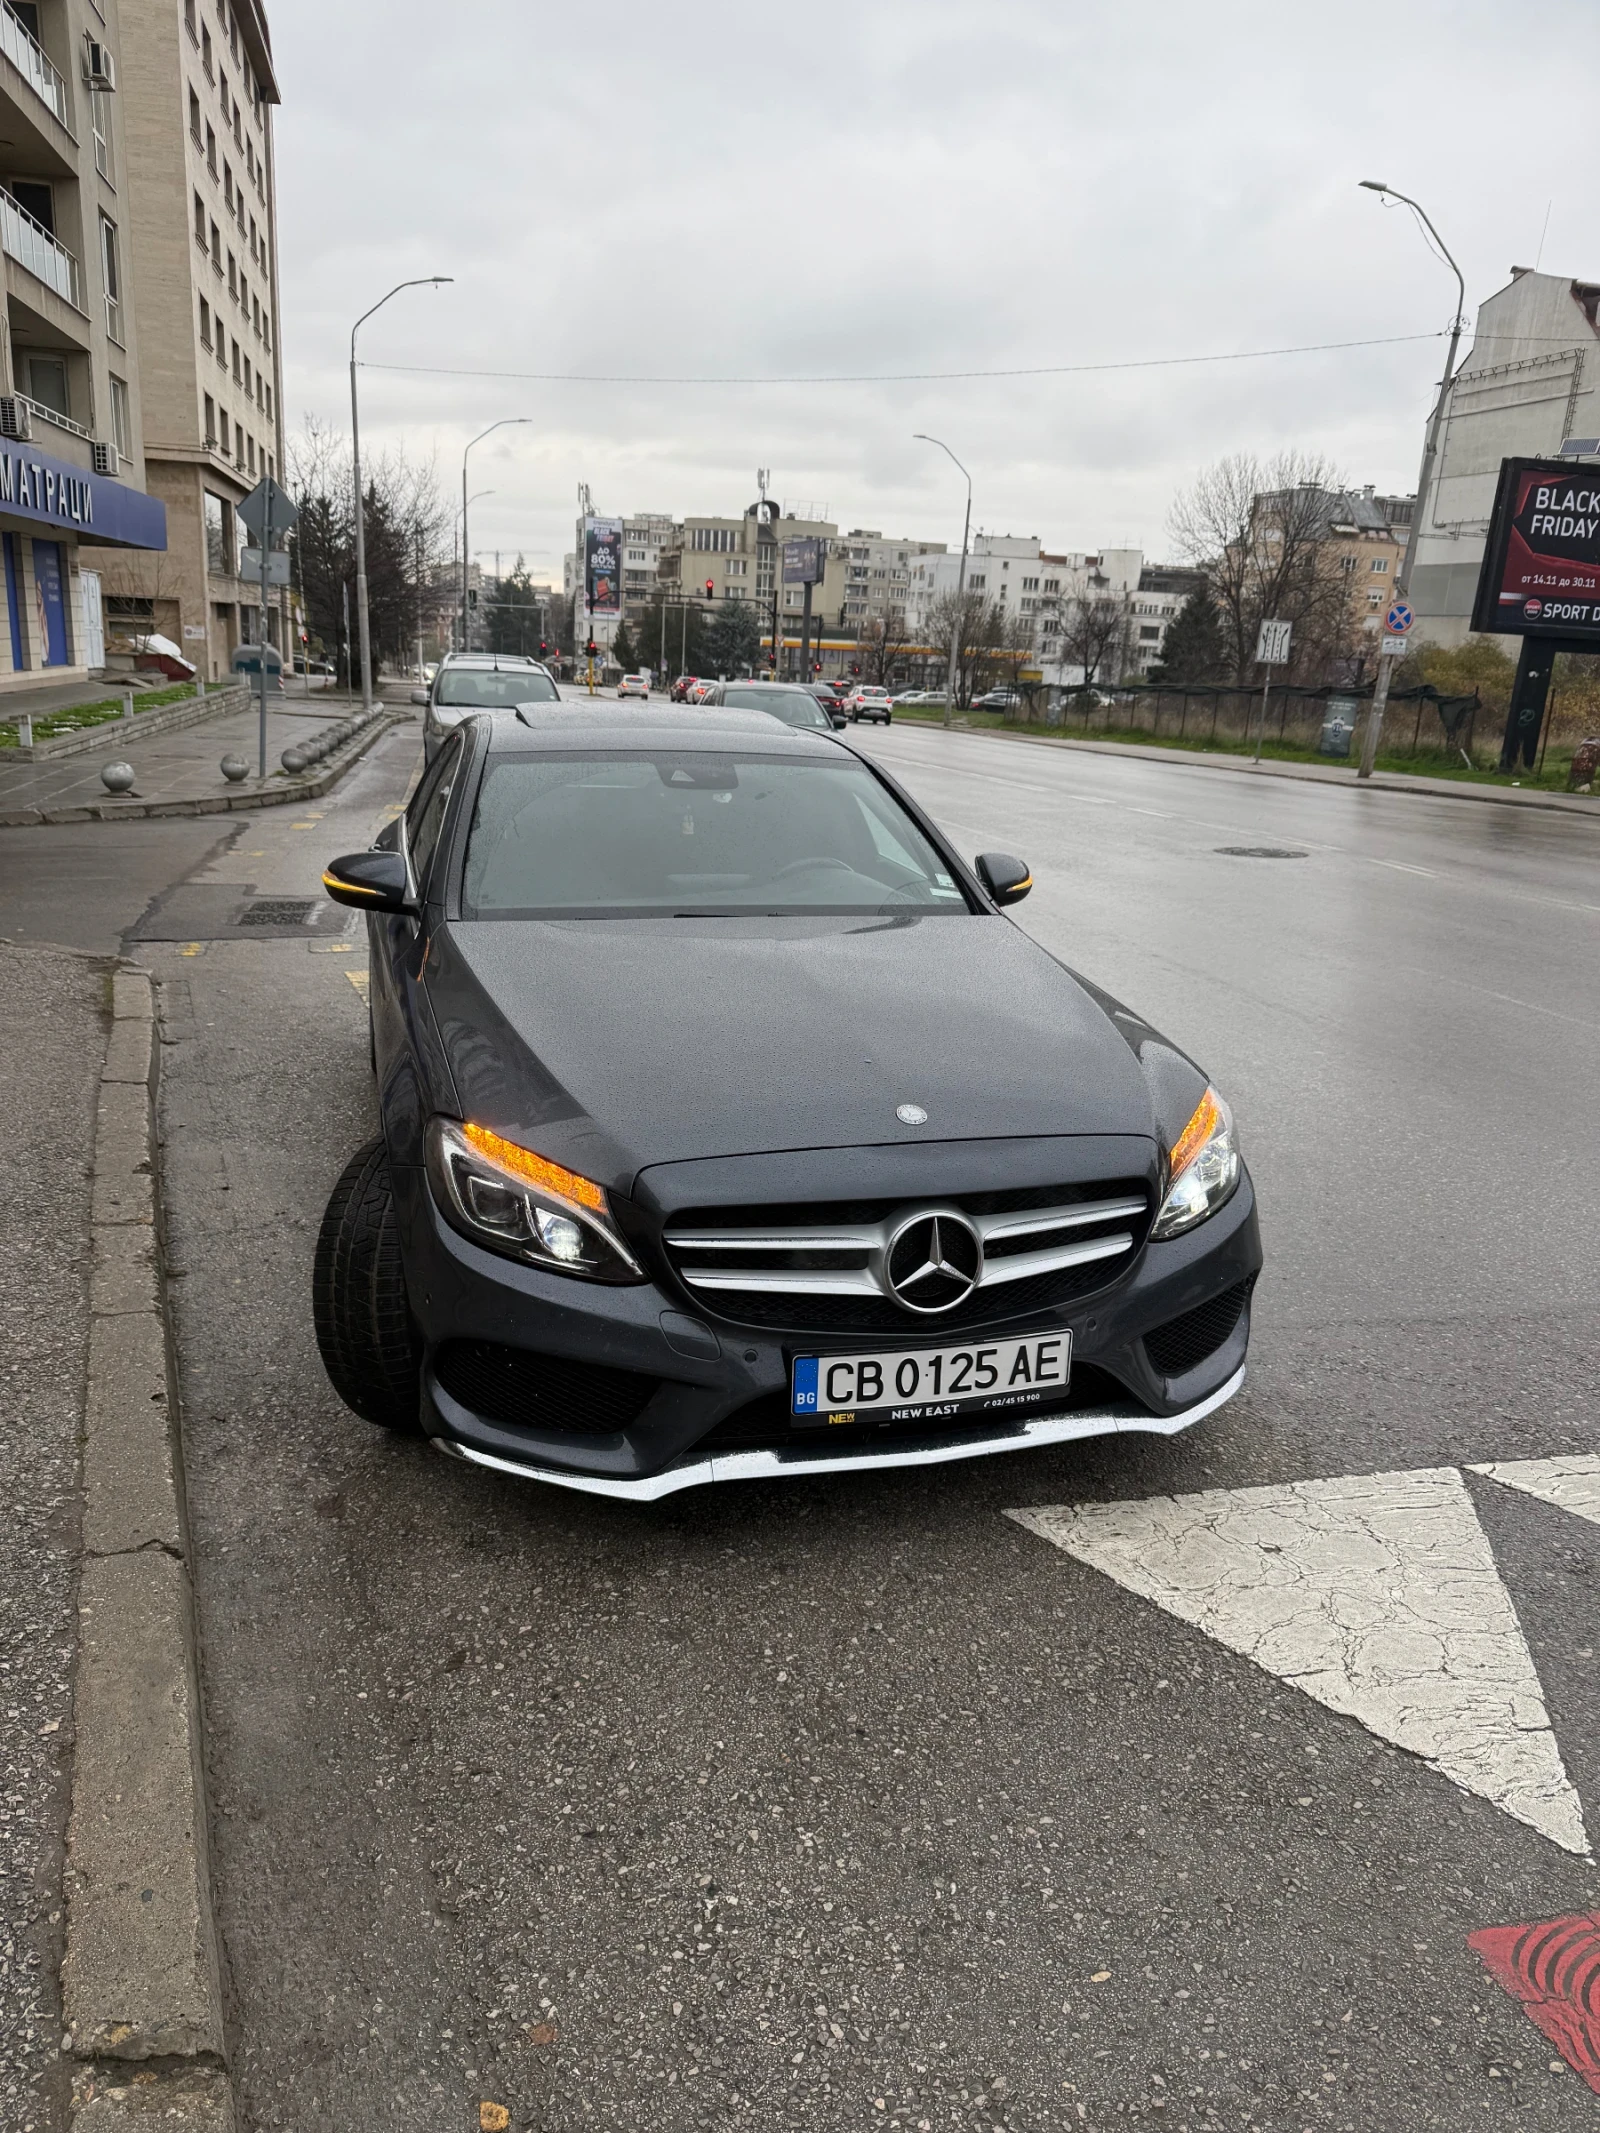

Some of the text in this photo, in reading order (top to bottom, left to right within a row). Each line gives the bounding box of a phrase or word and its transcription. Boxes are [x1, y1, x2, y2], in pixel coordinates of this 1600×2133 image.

[0, 451, 93, 524] МАТРАЦИ
[1535, 487, 1600, 513] BLACK
[1530, 514, 1599, 538] FRIDAY
[590, 554, 615, 565] 80%
[1521, 574, 1596, 588] от 14.11 до 30.11
[1543, 603, 1590, 620] SPORT
[826, 1340, 1061, 1403] CB 0125 AE
[796, 1392, 815, 1405] BG
[991, 1393, 1040, 1407] 02/45 15 900
[891, 1404, 960, 1420] NEW EAST
